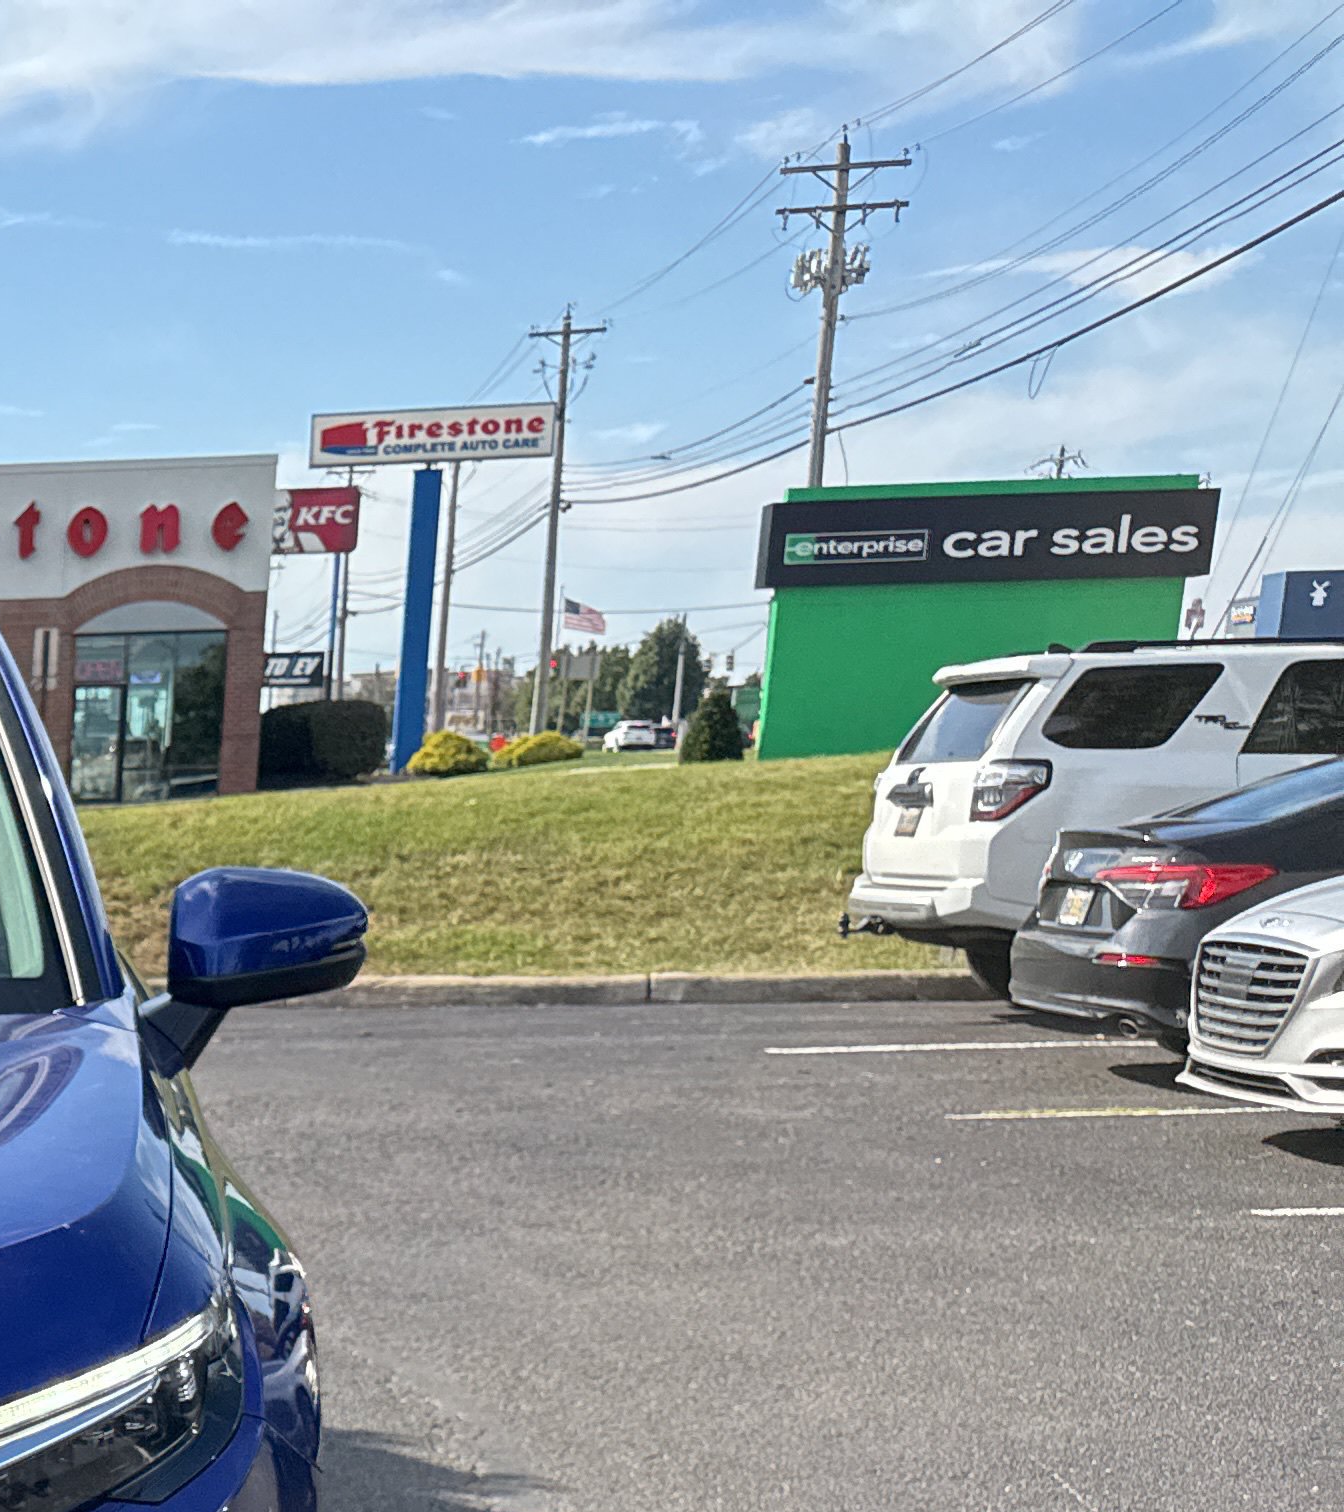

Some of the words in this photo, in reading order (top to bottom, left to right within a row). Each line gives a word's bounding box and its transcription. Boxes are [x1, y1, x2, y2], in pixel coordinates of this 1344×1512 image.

[373, 416, 545, 445] Firestone
[382, 441, 457, 455] COMPLETE
[461, 439, 499, 451] AUTO
[502, 437, 540, 449] CARE
[295, 504, 354, 527] KFC
[792, 535, 924, 558] enterprise
[942, 528, 1039, 558] car
[1050, 514, 1200, 556] sales
